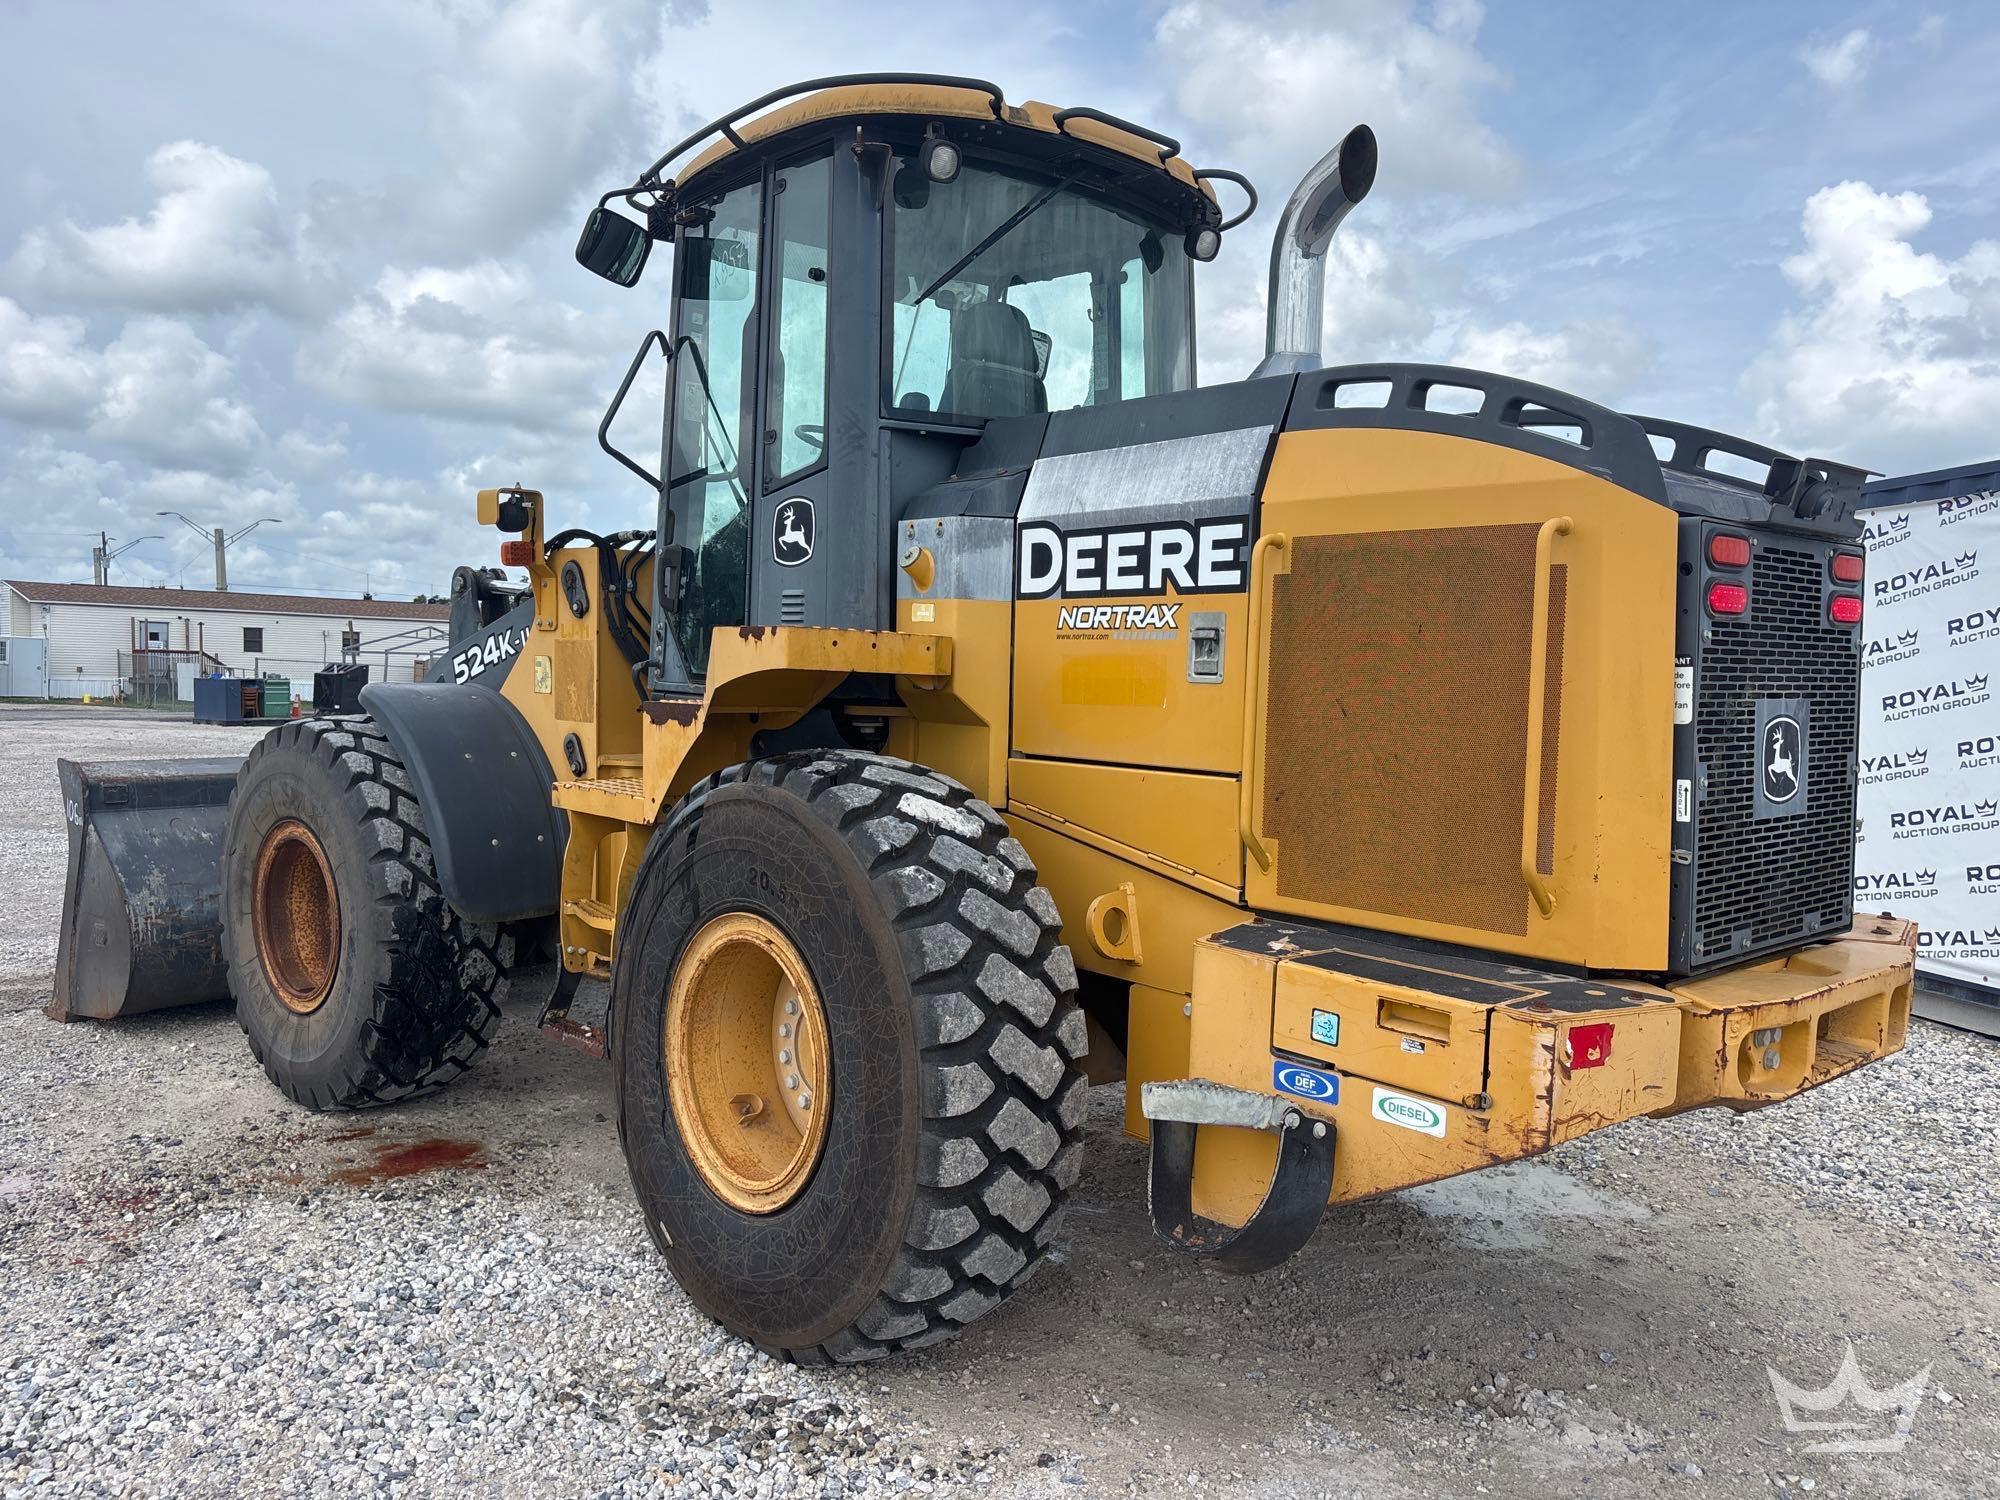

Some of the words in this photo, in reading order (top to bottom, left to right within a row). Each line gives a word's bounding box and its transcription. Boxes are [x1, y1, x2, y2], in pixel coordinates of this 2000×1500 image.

[1939, 499, 1999, 527] AUCTION
[1869, 531, 1912, 552] GROUP
[1019, 521, 1245, 595] DEERE
[1874, 561, 1955, 596] ROYAL
[1876, 585, 1931, 608] AUCTION
[1933, 569, 1979, 590] GROUP
[1057, 602, 1183, 630] NORTRAX
[1947, 606, 2000, 635] ROY
[1056, 631, 1110, 641] www.nortrax.com
[1949, 627, 2000, 647] AUCTIO
[1877, 648, 1920, 666] GROUP
[1882, 681, 1965, 711] ROYAL
[1884, 703, 1940, 723] AUCTION
[1942, 693, 1991, 711] GROUP
[1960, 755, 2000, 770] AUCTI
[1885, 767, 1930, 782] GROUP
[1890, 804, 1975, 828] ROYAL
[1892, 825, 1950, 840] AUCTION
[1951, 819, 2000, 834] GROUP
[1854, 872, 1915, 890] OYAL
[1855, 892, 1892, 902] CTION
[1894, 888, 1939, 900] GROUP
[1917, 929, 1984, 947] OYAL
[1960, 949, 2000, 958] GROU
[1295, 1075, 1317, 1090] DEF
[1387, 1102, 1430, 1124] DIESEL
